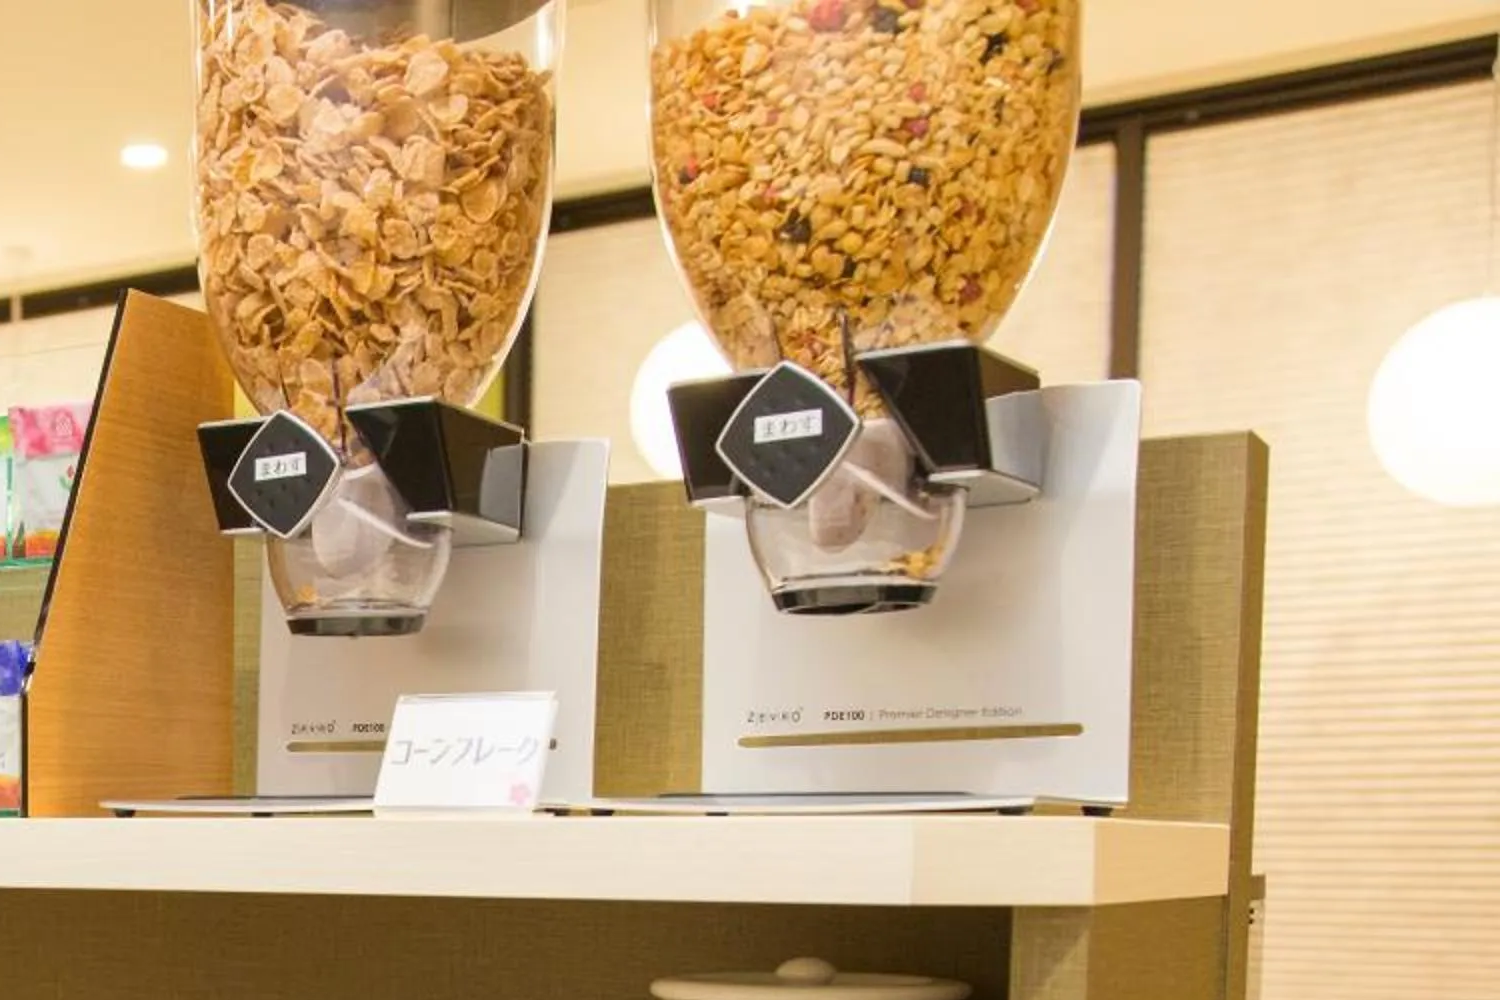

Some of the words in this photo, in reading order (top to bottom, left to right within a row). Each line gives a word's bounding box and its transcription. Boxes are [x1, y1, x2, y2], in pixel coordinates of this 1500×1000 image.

[262, 459, 301, 477] まわす
[391, 736, 541, 766] コーンフレーク
